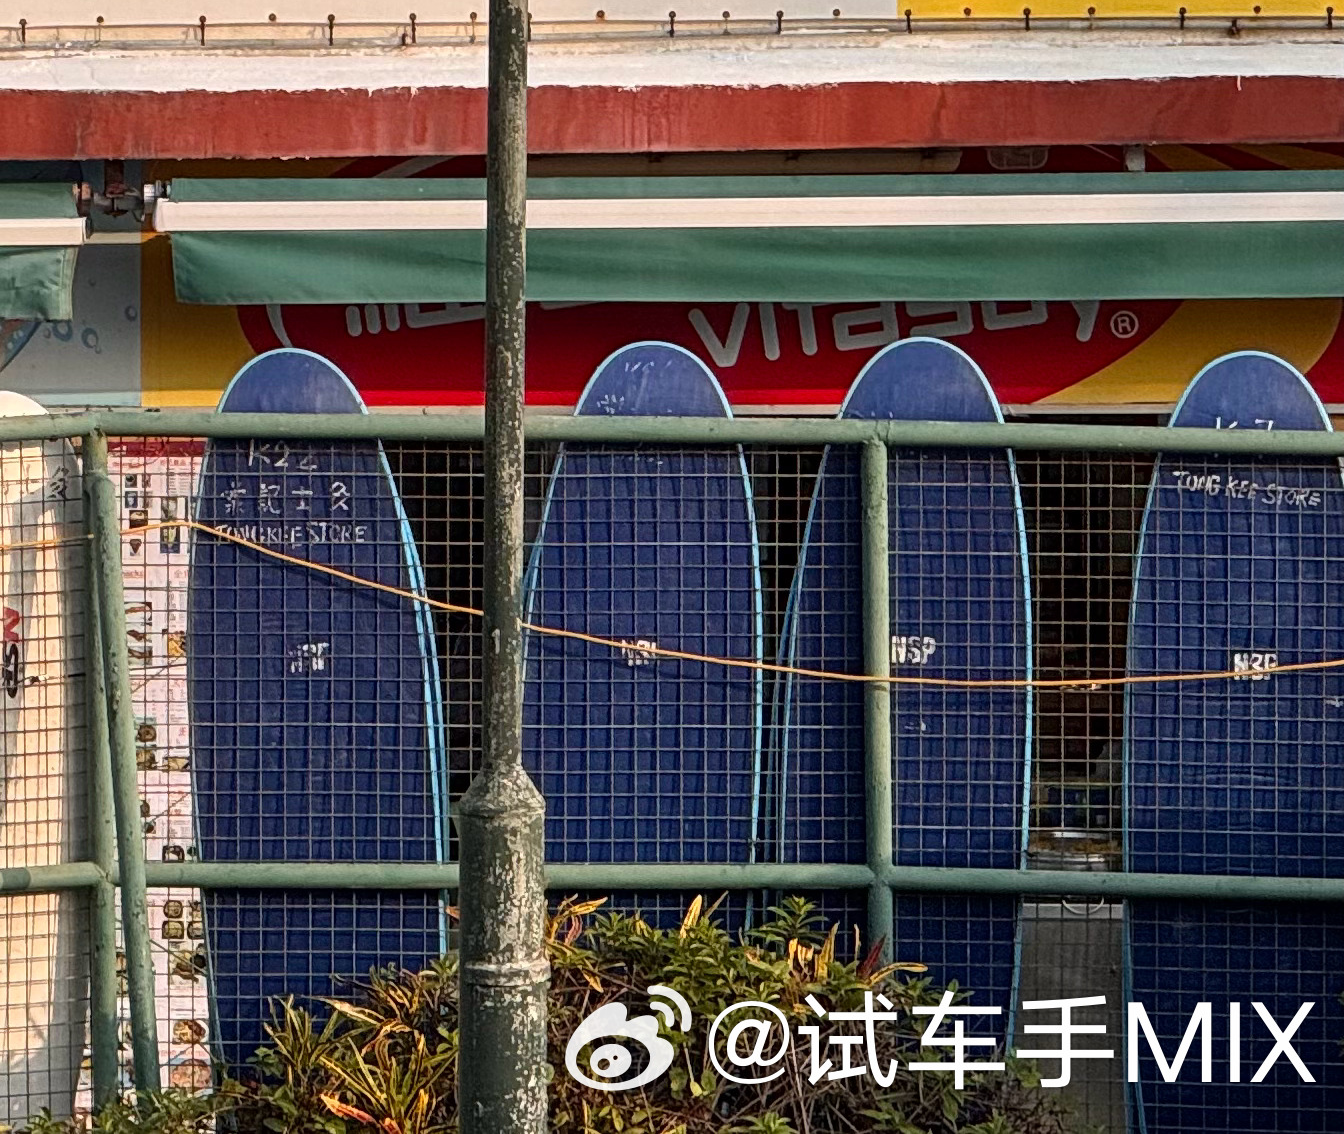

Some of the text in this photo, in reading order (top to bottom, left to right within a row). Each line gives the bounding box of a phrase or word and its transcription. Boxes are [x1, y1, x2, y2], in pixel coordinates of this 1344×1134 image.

[1173, 470, 1322, 508] TONG KEE STORE
[891, 635, 937, 664] NSP
